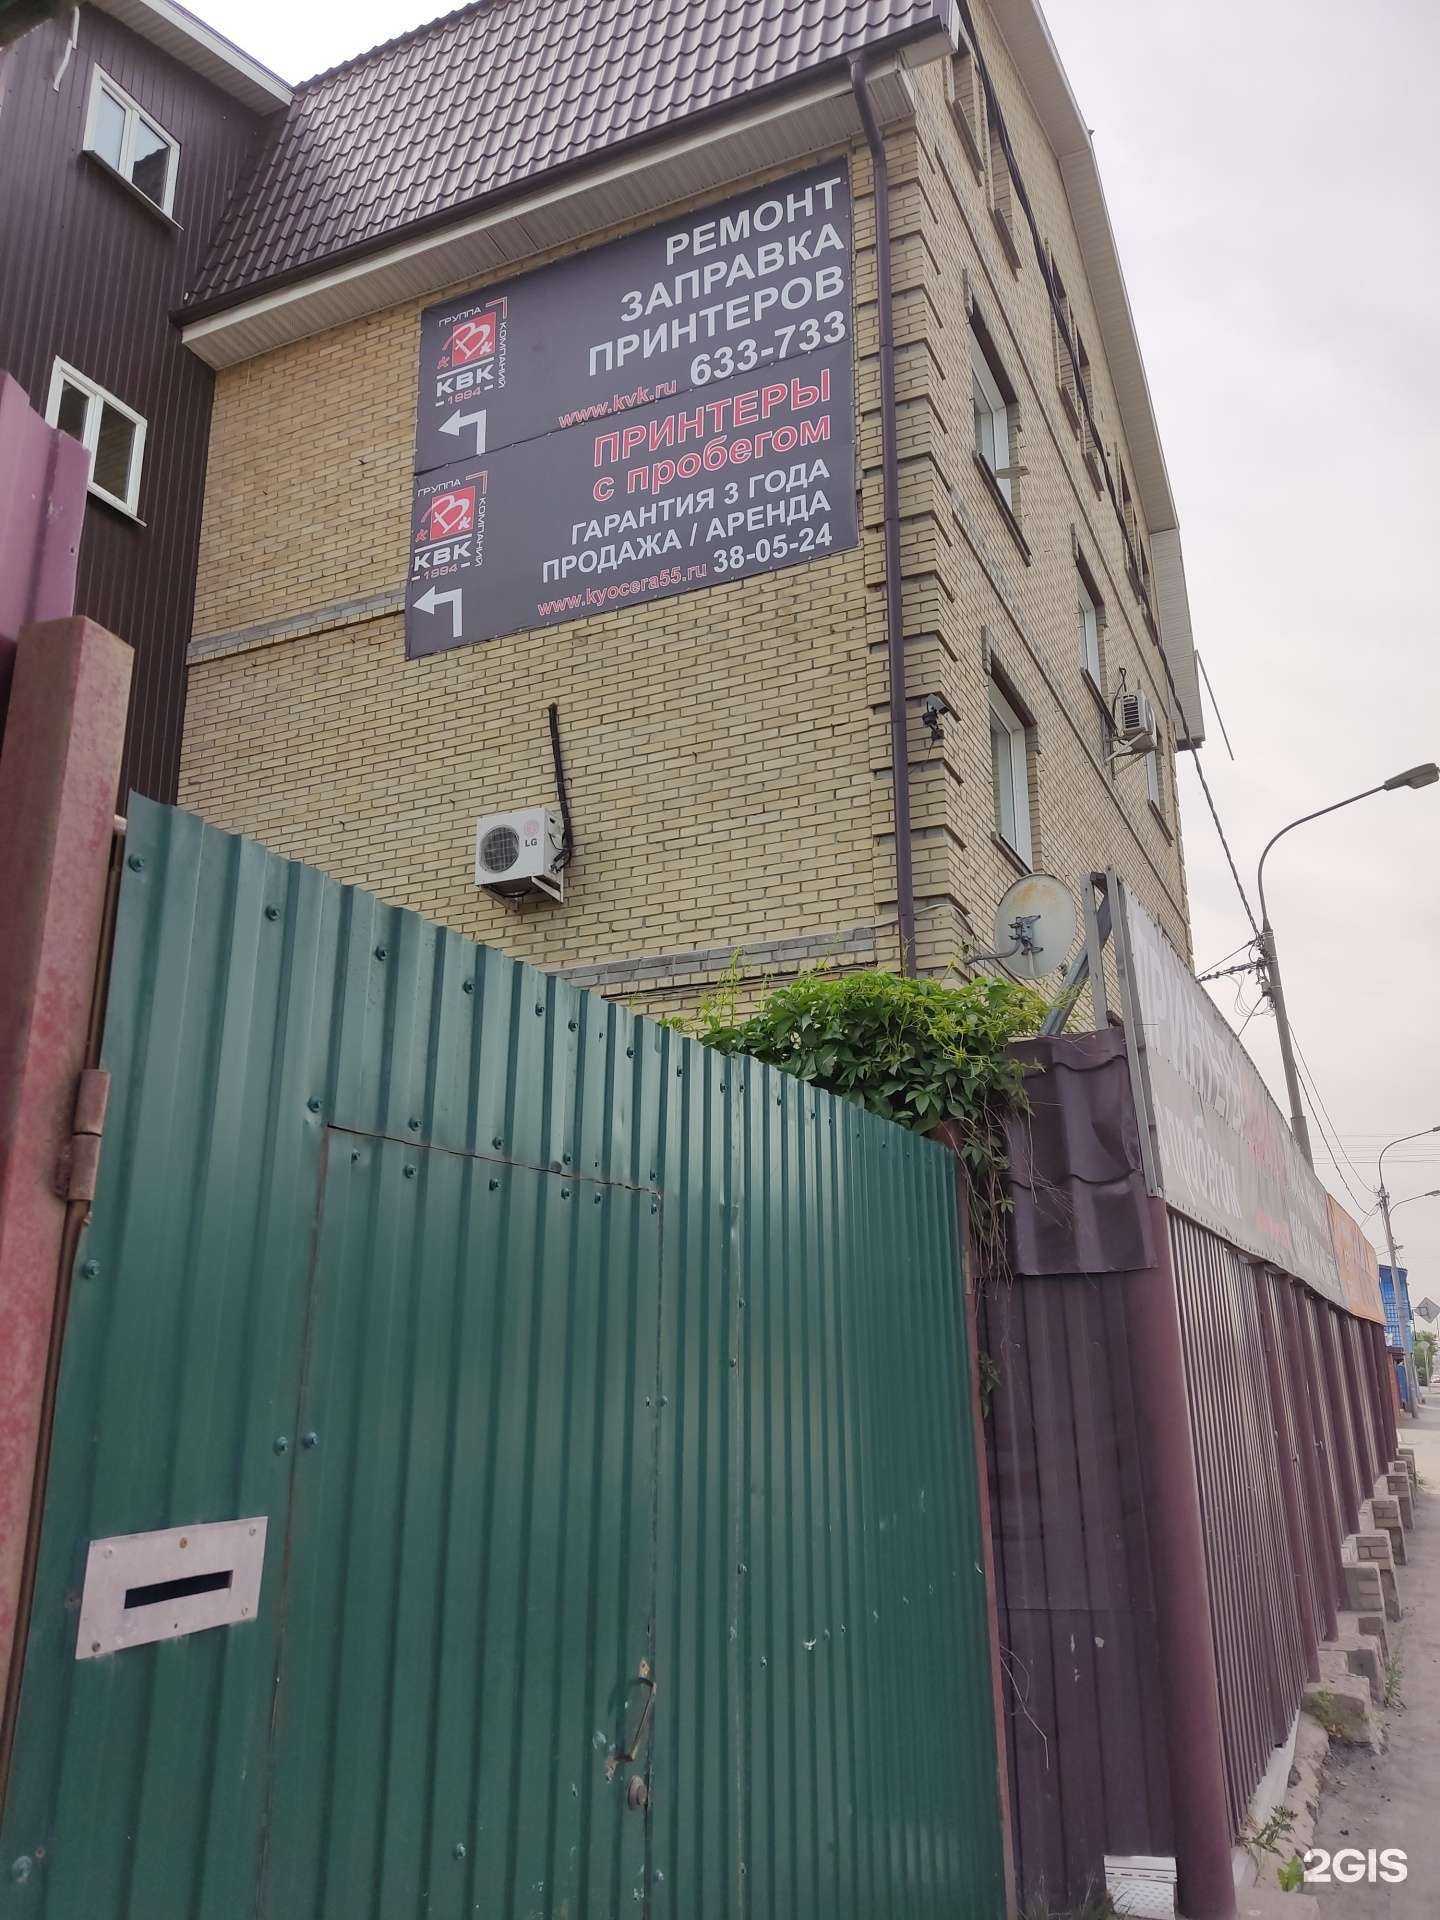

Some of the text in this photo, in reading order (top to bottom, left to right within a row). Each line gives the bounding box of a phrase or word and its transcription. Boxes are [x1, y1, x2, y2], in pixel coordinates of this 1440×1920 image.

[666, 177, 842, 266] РЕМОНТ
[438, 306, 482, 327] ГРУППА
[621, 223, 844, 323] ЗАПРАВКА
[589, 265, 845, 377] ПРИНТЕРОВ
[690, 310, 847, 386] 633-733
[436, 364, 495, 398] КВК
[558, 379, 678, 428] www.kvk.ru
[593, 368, 831, 467] ПРИНТЕРЫ
[417, 478, 462, 497] ГРУППА
[571, 458, 831, 545] ГАРАНТИЯ 3 ГОДА
[592, 414, 831, 502] с пробегом
[413, 540, 473, 572] КВК
[537, 522, 833, 616] www.kyocera55.ru 38-05-24
[542, 528, 682, 583] ПРОДАЖА
[705, 489, 832, 542] АРЕНДА
[525, 838, 538, 847] LG
